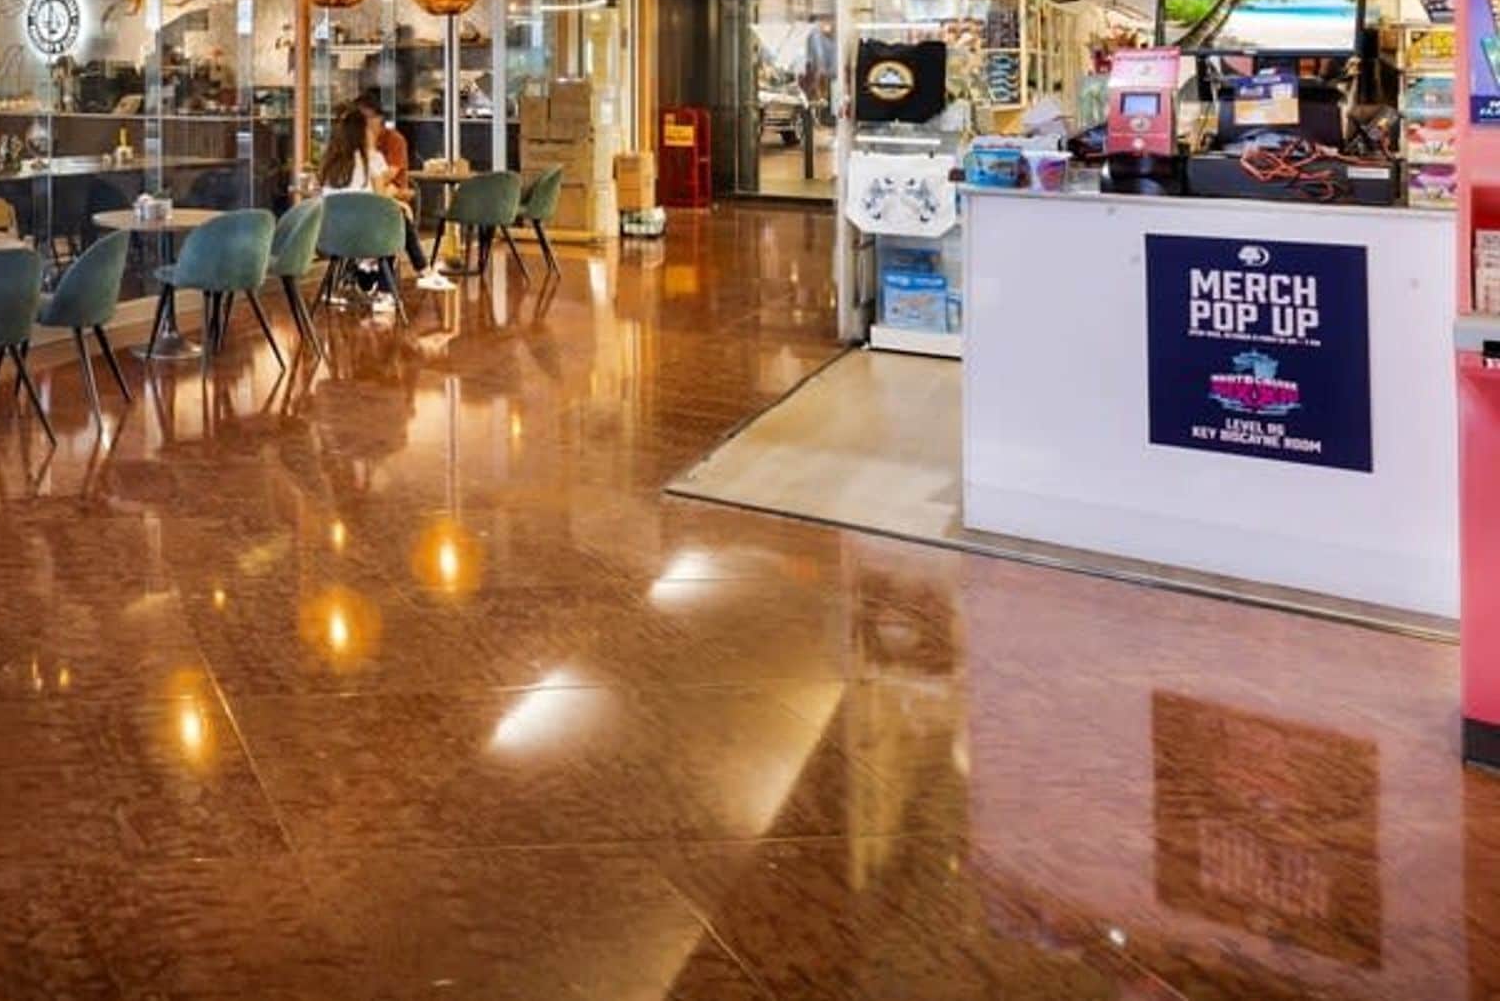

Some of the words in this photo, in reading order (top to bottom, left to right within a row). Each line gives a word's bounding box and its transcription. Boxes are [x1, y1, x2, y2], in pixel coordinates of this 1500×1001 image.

[1190, 268, 1317, 307] MERCH
[1190, 299, 1259, 333] POP
[1272, 306, 1319, 338] UP
[1192, 425, 1216, 439] KEY
[1283, 436, 1322, 453] ROOM
[1225, 418, 1263, 434] LEVEL
